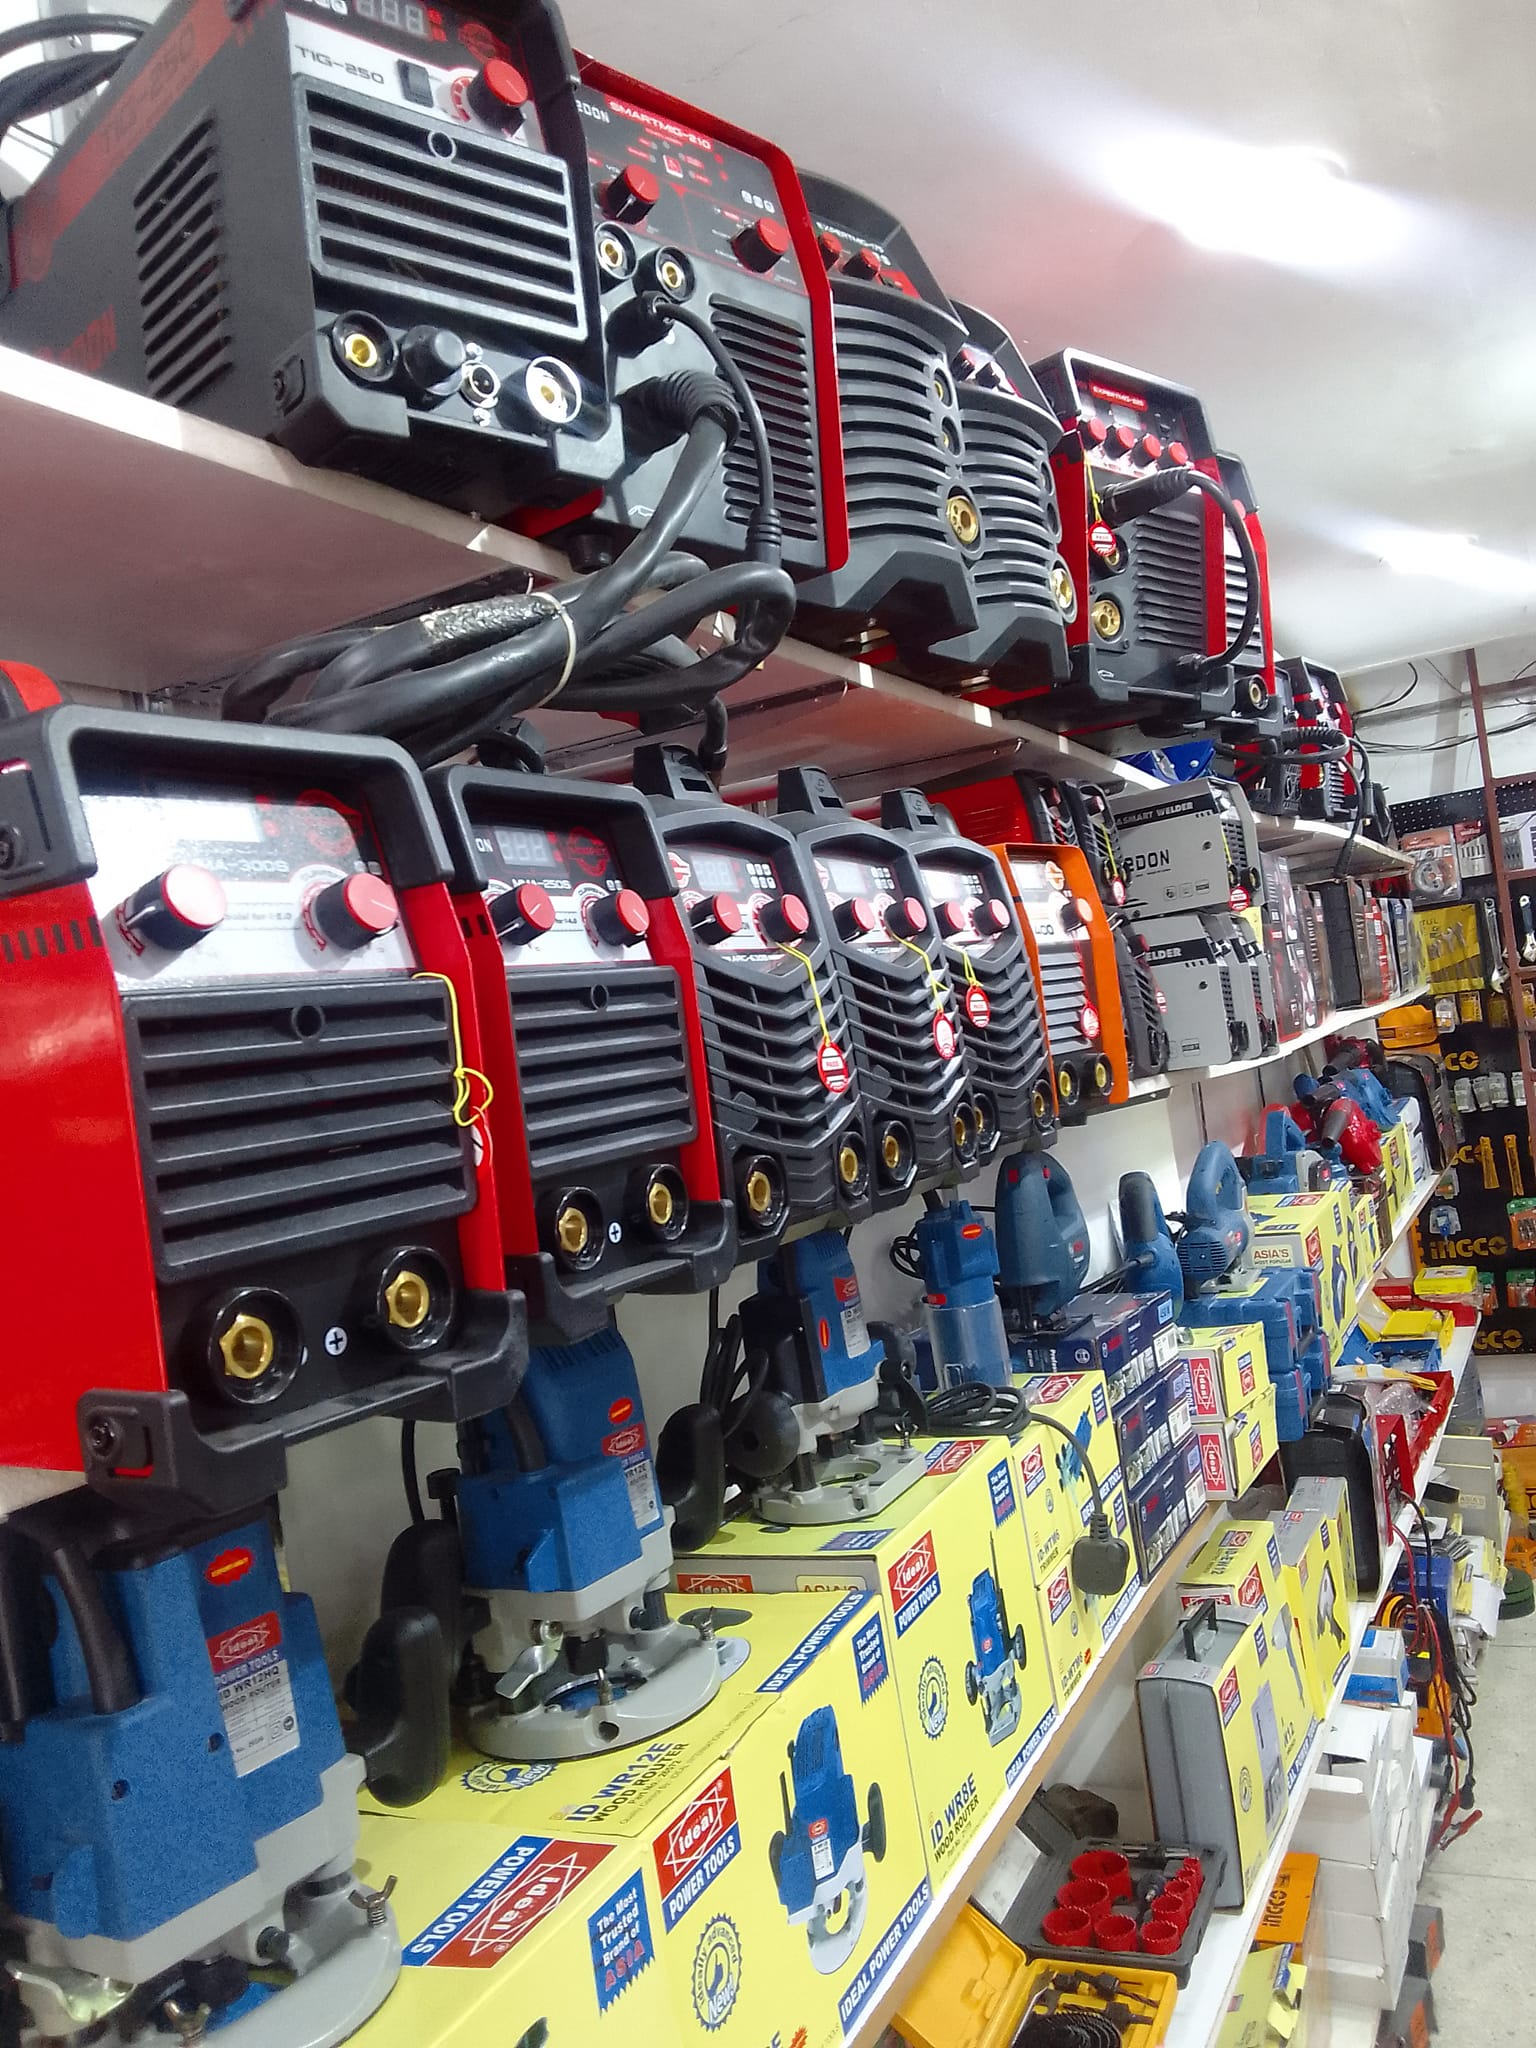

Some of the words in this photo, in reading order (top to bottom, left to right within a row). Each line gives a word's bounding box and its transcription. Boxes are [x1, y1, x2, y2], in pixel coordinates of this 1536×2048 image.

[294, 44, 385, 85] TIG-250
[1156, 801, 1194, 817] WELDER
[1145, 947, 1182, 961] ELDER
[1253, 1248, 1290, 1260] ASIA'S
[901, 1555, 925, 1586] Ideal
[897, 1597, 921, 1630] POWER
[917, 1580, 939, 1610] TOOLS
[762, 1653, 802, 1692] IDEAL
[797, 1623, 833, 1661] POWER
[830, 1592, 864, 1629] TOOLS
[565, 1803, 601, 1822] ID
[591, 1743, 675, 1801] WR12E
[588, 1788, 637, 1823] WOOD
[630, 1742, 690, 1792] ROUTER
[677, 1806, 715, 1856] Ideal
[929, 1818, 944, 1849] ID
[943, 1772, 977, 1828] WR8E
[933, 1828, 955, 1863] WOOD
[952, 1794, 981, 1835] ROUTER
[467, 1845, 538, 1901] POWER
[668, 1869, 705, 1921] POWER
[702, 1834, 736, 1883] TOOLS
[410, 1901, 482, 1954] TOOLS
[490, 1876, 561, 1931] Ideal
[596, 1914, 616, 1936] The
[614, 1886, 638, 1915] Most
[599, 1901, 640, 1951] Trusted
[602, 1937, 629, 1968] Brand
[628, 1921, 641, 1943] of
[604, 1940, 646, 1992] ASIA
[839, 1973, 871, 2023] IDEAL
[868, 1925, 903, 1985] POWER
[900, 1882, 930, 1933] TOOLS
